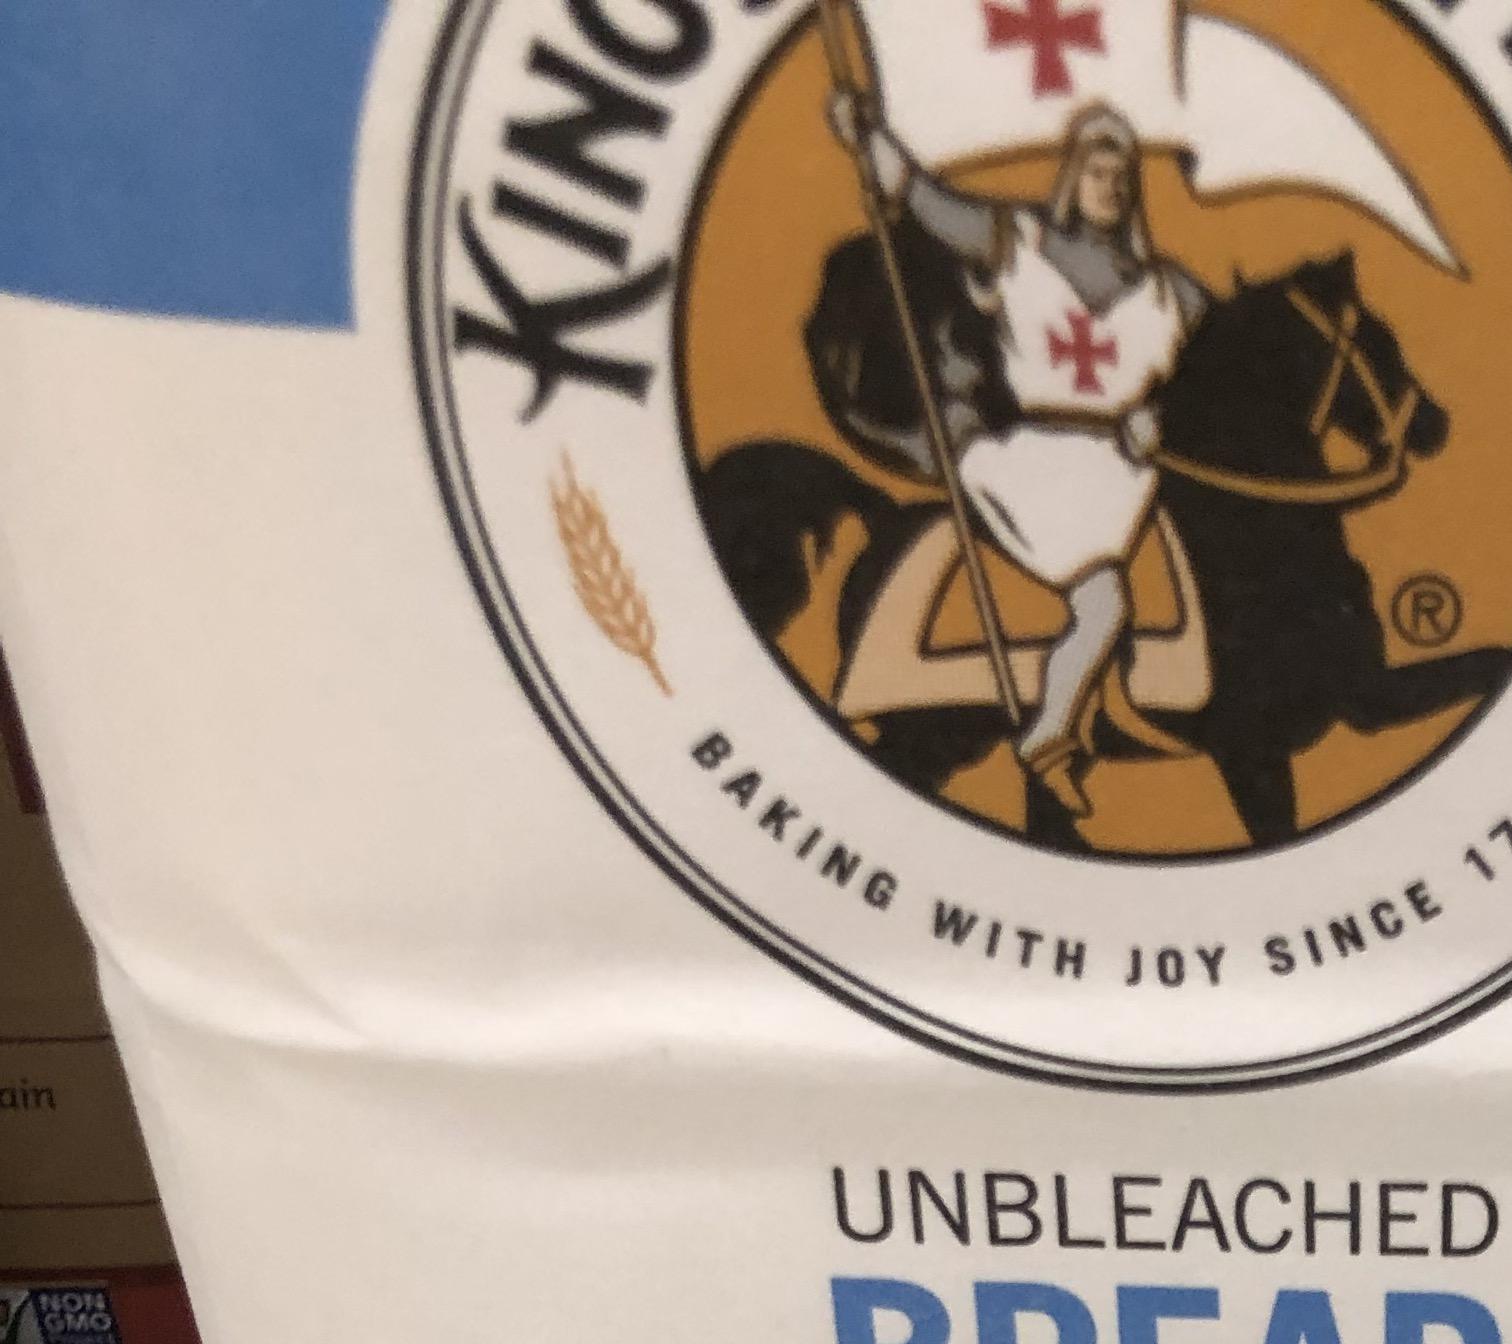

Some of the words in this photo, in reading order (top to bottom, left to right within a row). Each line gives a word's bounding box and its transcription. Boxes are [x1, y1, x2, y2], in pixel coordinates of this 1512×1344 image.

[689, 729, 900, 912] BAKING
[931, 898, 1087, 981] WITH
[1125, 946, 1228, 988] JOY
[1264, 880, 1444, 977] SINCE
[831, 1166, 1500, 1257] UNBLEACHED
[38, 1291, 107, 1312] NON
[44, 1312, 113, 1335] GMO
